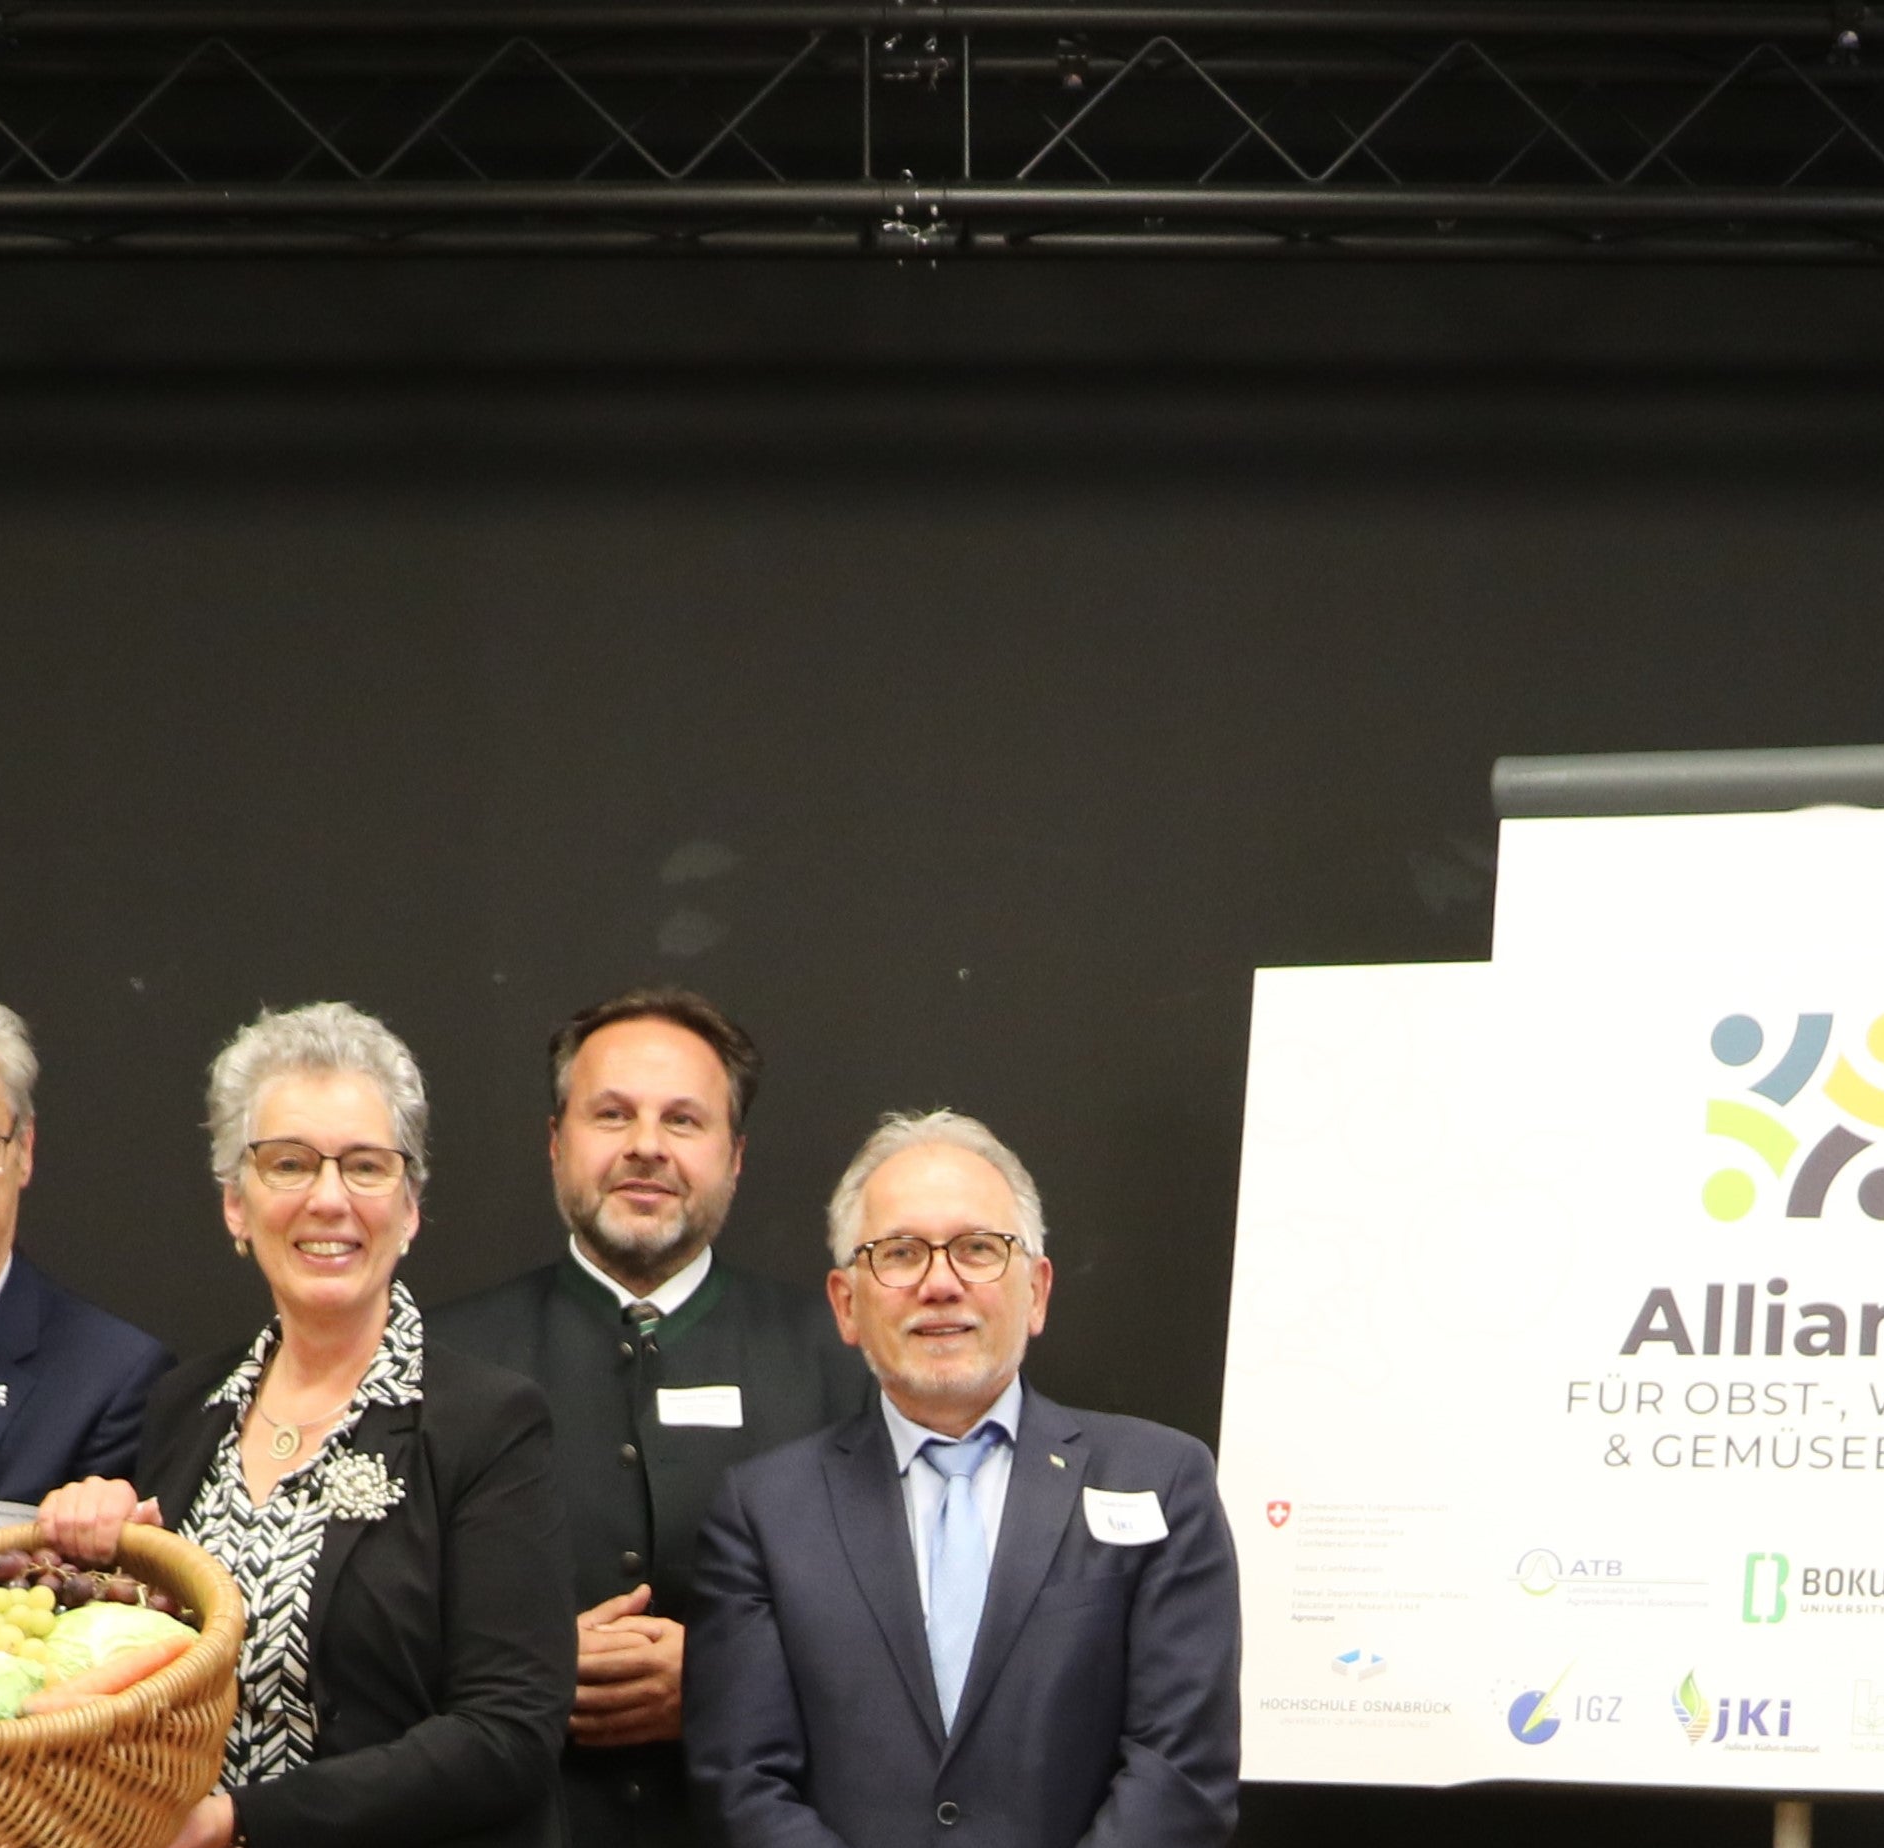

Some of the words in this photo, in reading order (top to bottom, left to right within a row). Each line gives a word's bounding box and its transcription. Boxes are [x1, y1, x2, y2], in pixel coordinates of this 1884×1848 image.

[1567, 1374, 1664, 1415] FÜR
[1685, 1382, 1847, 1423] OBST-,
[1604, 1434, 1631, 1467] &
[1569, 1560, 1623, 1577] ATB
[1291, 1614, 1335, 1622] Agroscope
[1260, 1696, 1357, 1712] HOCHSCHULE
[1363, 1699, 1452, 1715] OSNABRÜCK
[1575, 1695, 1622, 1723] IGZ
